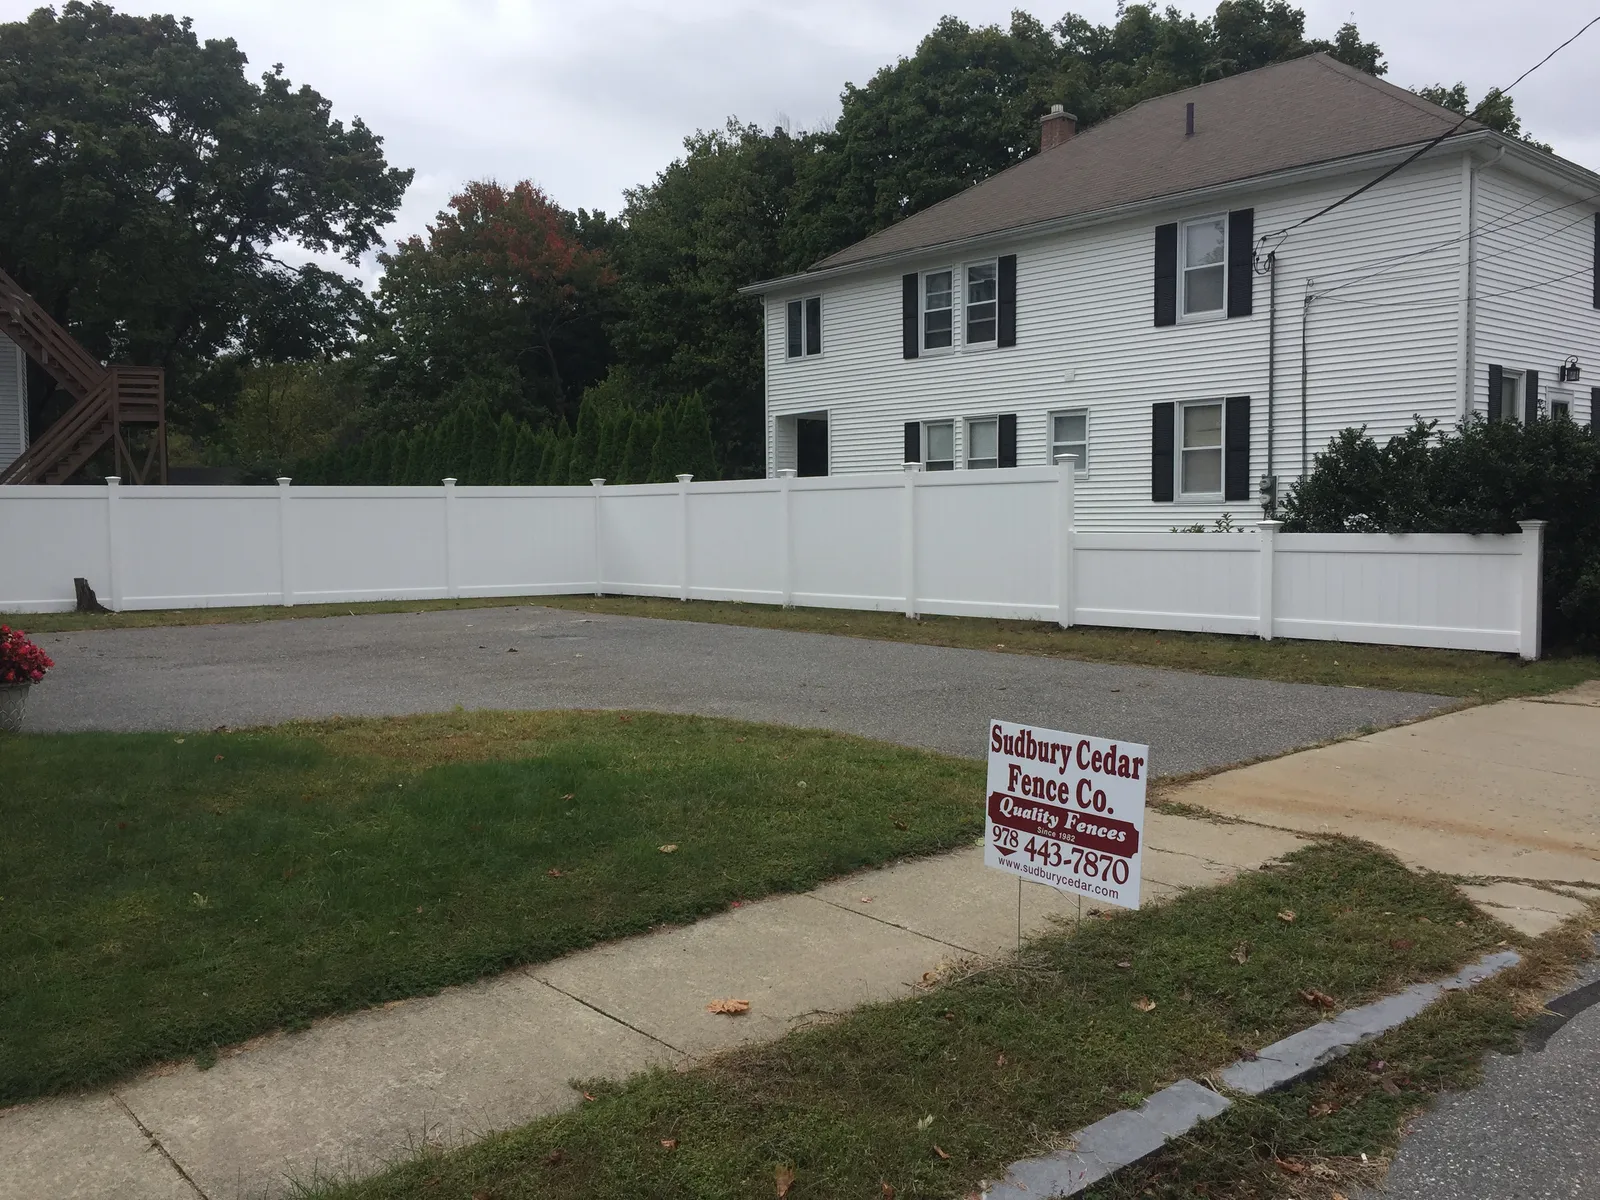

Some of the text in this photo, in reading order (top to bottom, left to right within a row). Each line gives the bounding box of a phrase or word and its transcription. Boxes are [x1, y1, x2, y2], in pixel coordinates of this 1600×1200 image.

[991, 724, 1144, 780] Sudbury Cedar
[1007, 763, 1114, 814] Fence Co.
[999, 797, 1127, 842] Quality Fences
[1037, 826, 1076, 843] Since 1982
[992, 825, 1129, 885] 978 443-7870
[998, 857, 1119, 900] www.sudburycedar.com
